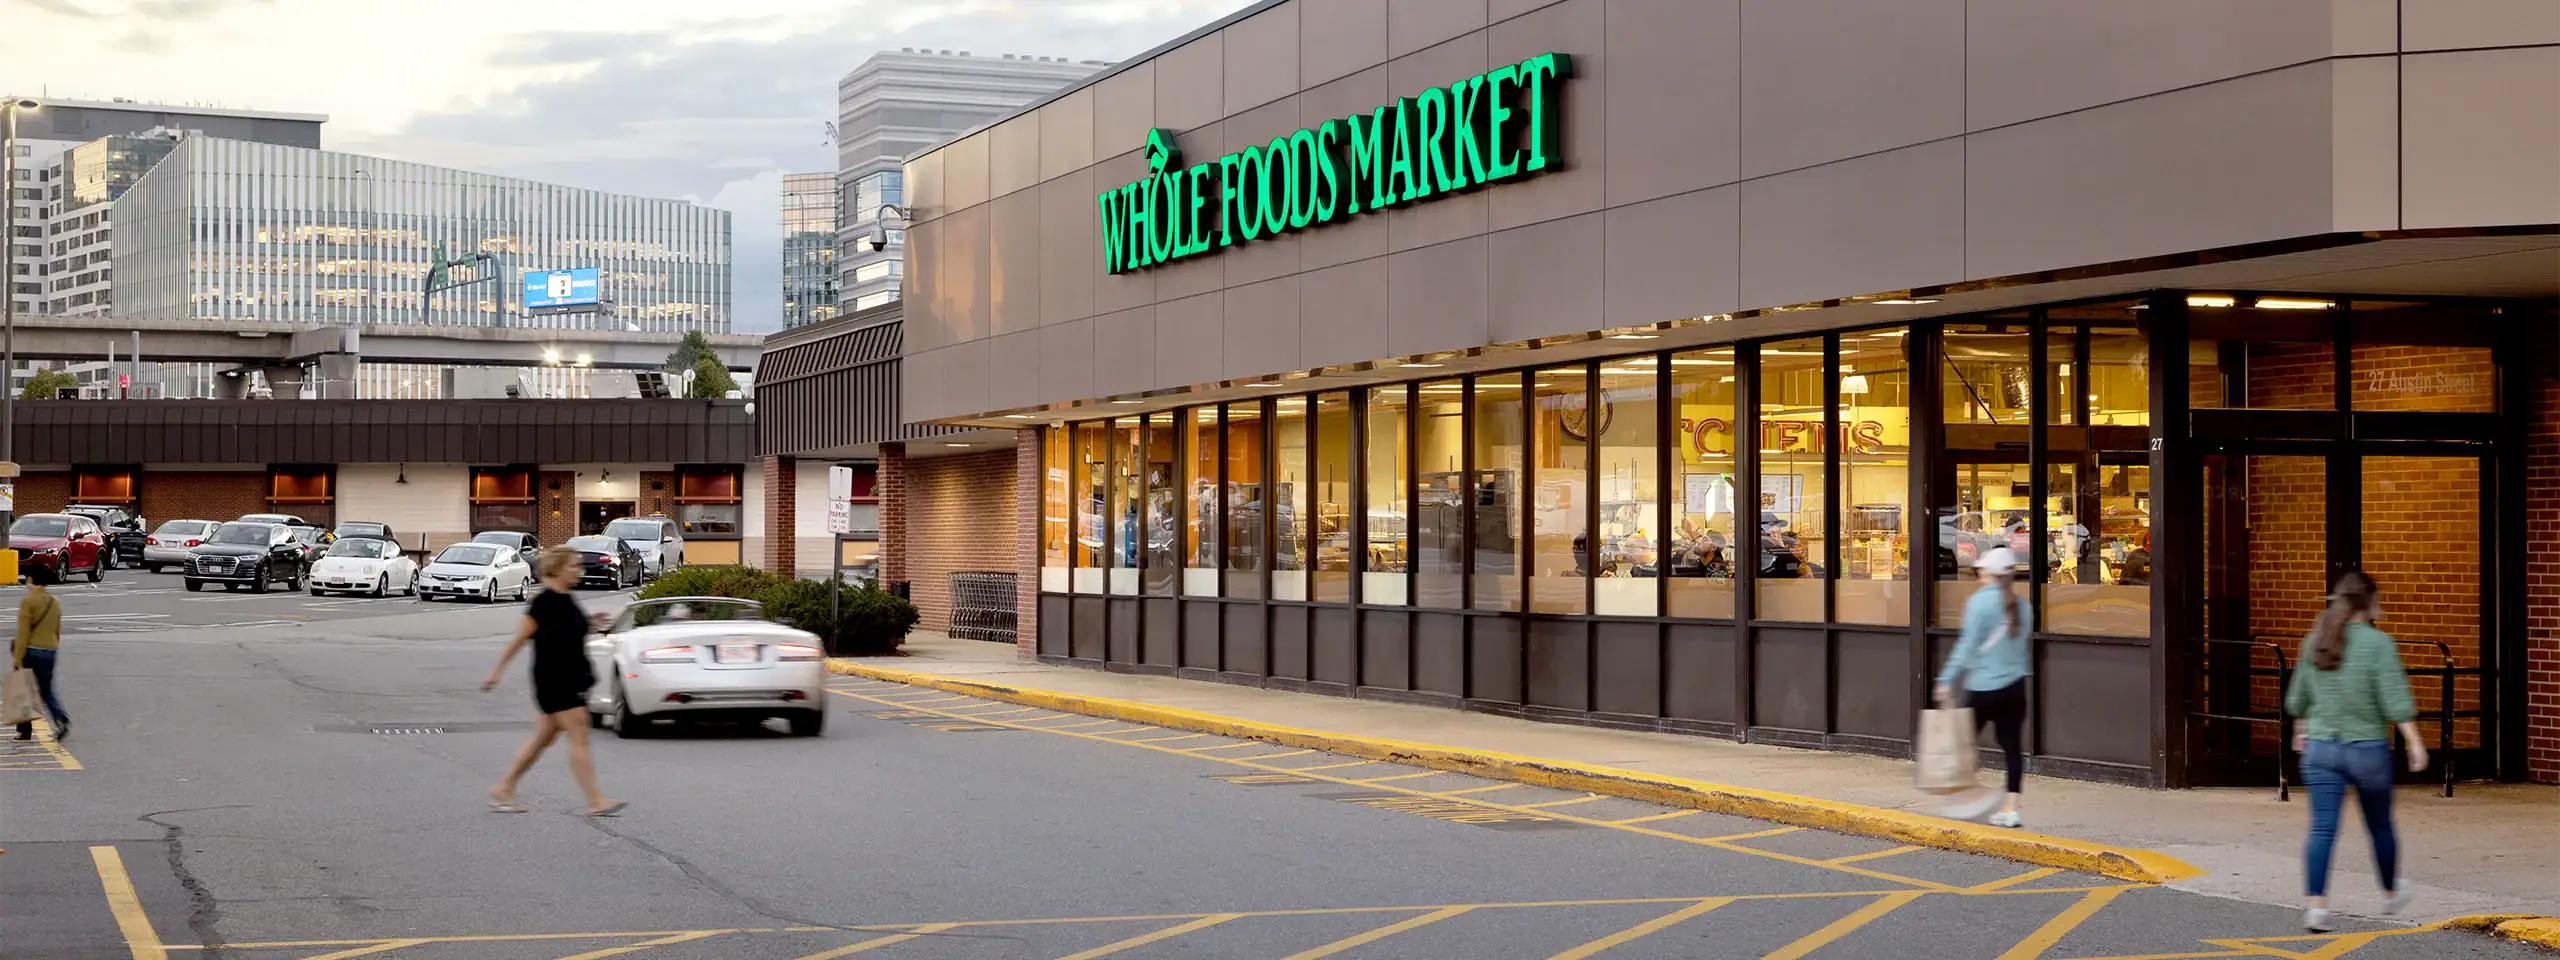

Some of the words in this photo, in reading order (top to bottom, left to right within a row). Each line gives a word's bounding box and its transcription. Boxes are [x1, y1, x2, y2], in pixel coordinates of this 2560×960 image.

[1098, 127, 1214, 275] WHOLE
[1219, 118, 1342, 247] FOODS
[1347, 51, 1564, 215] MARKET
[2368, 370, 2385, 392] 27
[2388, 370, 2432, 393] Austin
[1681, 417, 1884, 455] CENS
[2151, 437, 2163, 450] 27
